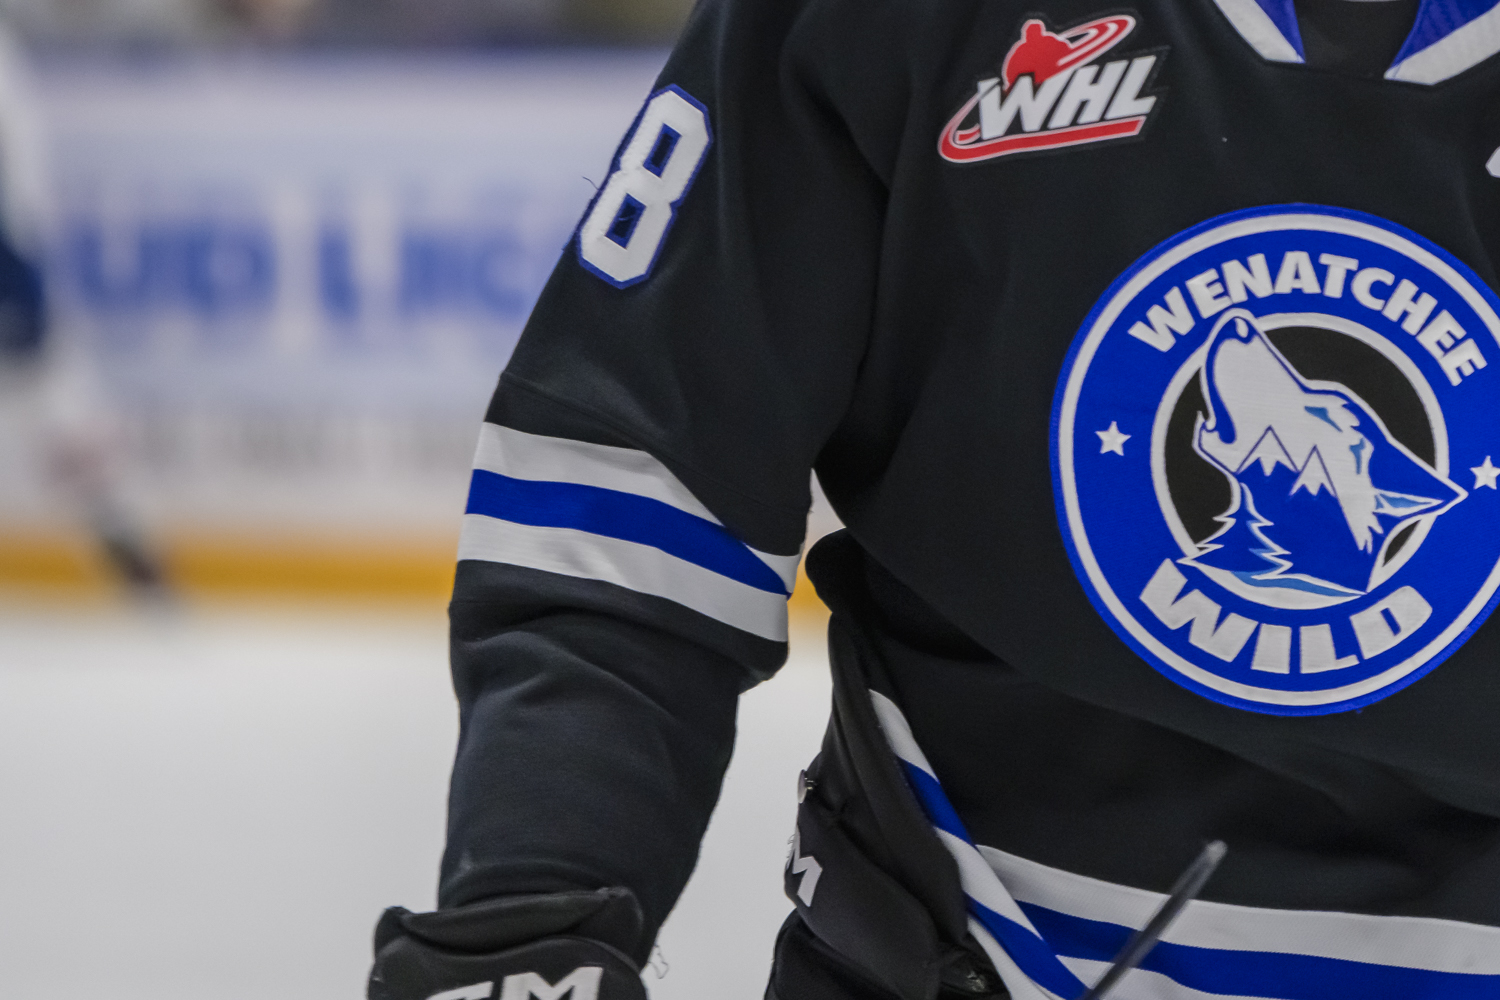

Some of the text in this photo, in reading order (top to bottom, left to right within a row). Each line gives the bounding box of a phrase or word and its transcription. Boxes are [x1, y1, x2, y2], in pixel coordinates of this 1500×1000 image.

[977, 55, 1157, 140] WHL
[1127, 250, 1488, 387] WENATCHEE
[1139, 557, 1433, 675] WILD
